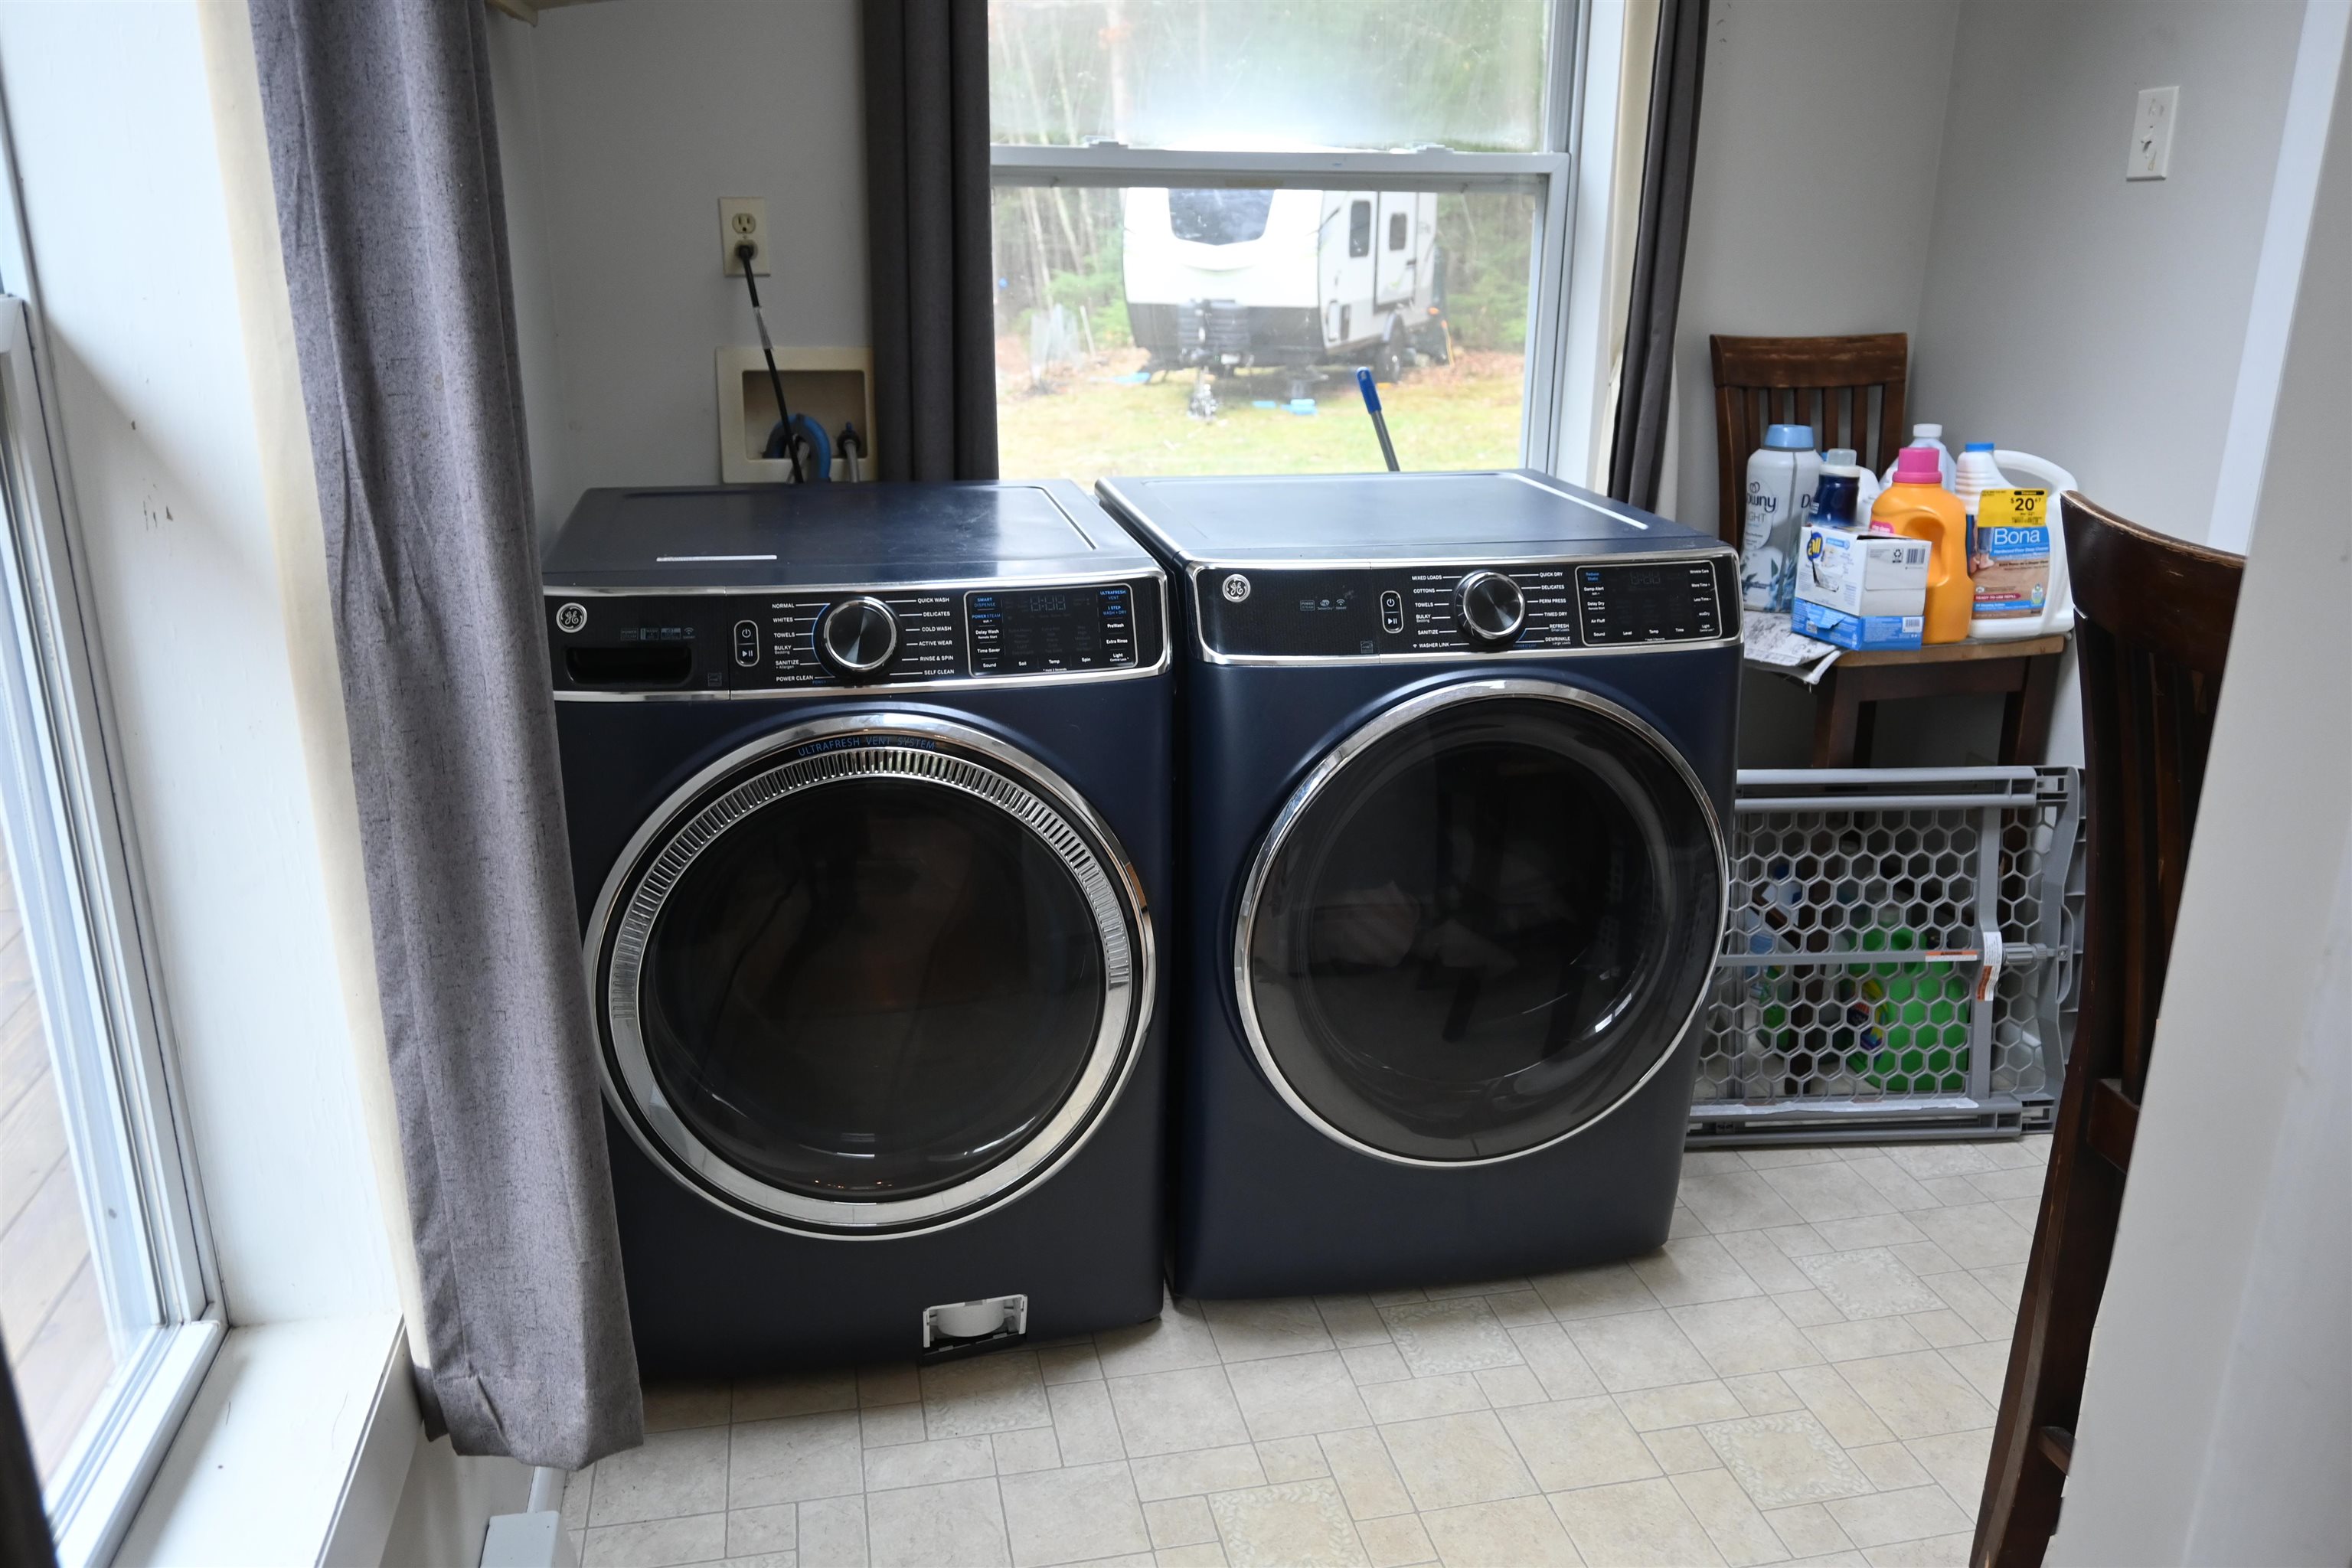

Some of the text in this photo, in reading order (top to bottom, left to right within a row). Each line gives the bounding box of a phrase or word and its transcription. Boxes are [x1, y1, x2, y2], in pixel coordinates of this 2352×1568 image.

[1994, 528, 2040, 545] Bona
[798, 736, 936, 756] ULTRAFRESH VENT SYSTEM
